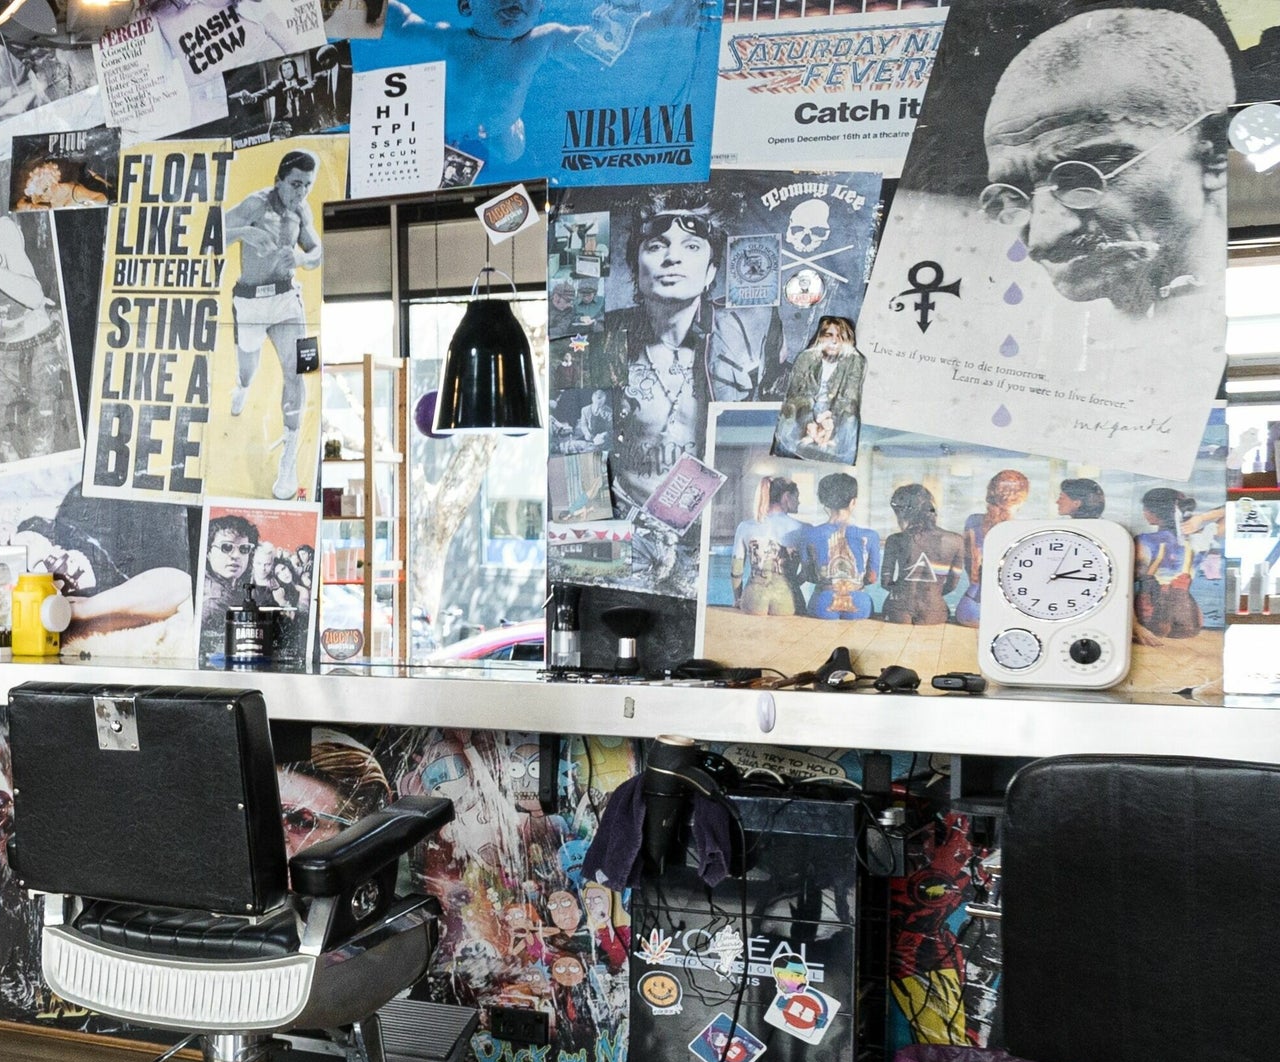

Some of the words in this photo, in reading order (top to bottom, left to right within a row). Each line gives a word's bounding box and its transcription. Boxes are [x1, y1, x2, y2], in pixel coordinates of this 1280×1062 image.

[99, 16, 154, 50] FERGIE
[178, 5, 241, 52] CASH
[188, 26, 246, 74] COW
[719, 33, 896, 73] SATURDAY
[384, 73, 408, 98] S
[801, 57, 928, 87] FEVER
[795, 99, 890, 125] Catch
[898, 97, 921, 119] it
[562, 104, 696, 149] NIRVANA
[767, 137, 795, 145] Opens
[797, 134, 840, 143] December
[843, 132, 860, 141] 16th
[561, 149, 693, 171] NEVERMIND
[120, 152, 234, 204] FLOAT
[115, 205, 192, 255] LIKE
[199, 206, 224, 255] A
[113, 259, 225, 287] BUTTERFLY
[107, 297, 218, 352] STING
[909, 350, 917, 360] if
[918, 353, 936, 363] you
[940, 357, 961, 367] were
[964, 361, 975, 369] to
[978, 361, 993, 372] die
[101, 352, 178, 402] LIKE
[185, 355, 210, 404] A
[952, 369, 980, 385] Learn
[997, 379, 1006, 389] if
[1007, 382, 1025, 392] you
[1029, 386, 1051, 397] were
[1054, 390, 1065, 398] to
[1068, 389, 1086, 402] live
[93, 403, 210, 493] BEE
[1035, 548, 1042, 556] 11
[1049, 543, 1064, 551] 12
[1013, 572, 1023, 581] 9
[1019, 559, 1034, 568] 10
[1082, 560, 1094, 568] 2
[1017, 587, 1028, 596] 8
[1081, 588, 1091, 596] 4
[1031, 598, 1041, 607] 7
[1067, 599, 1077, 608] 5
[1048, 603, 1058, 611] 6
[659, 928, 825, 967] L'OÉAL
